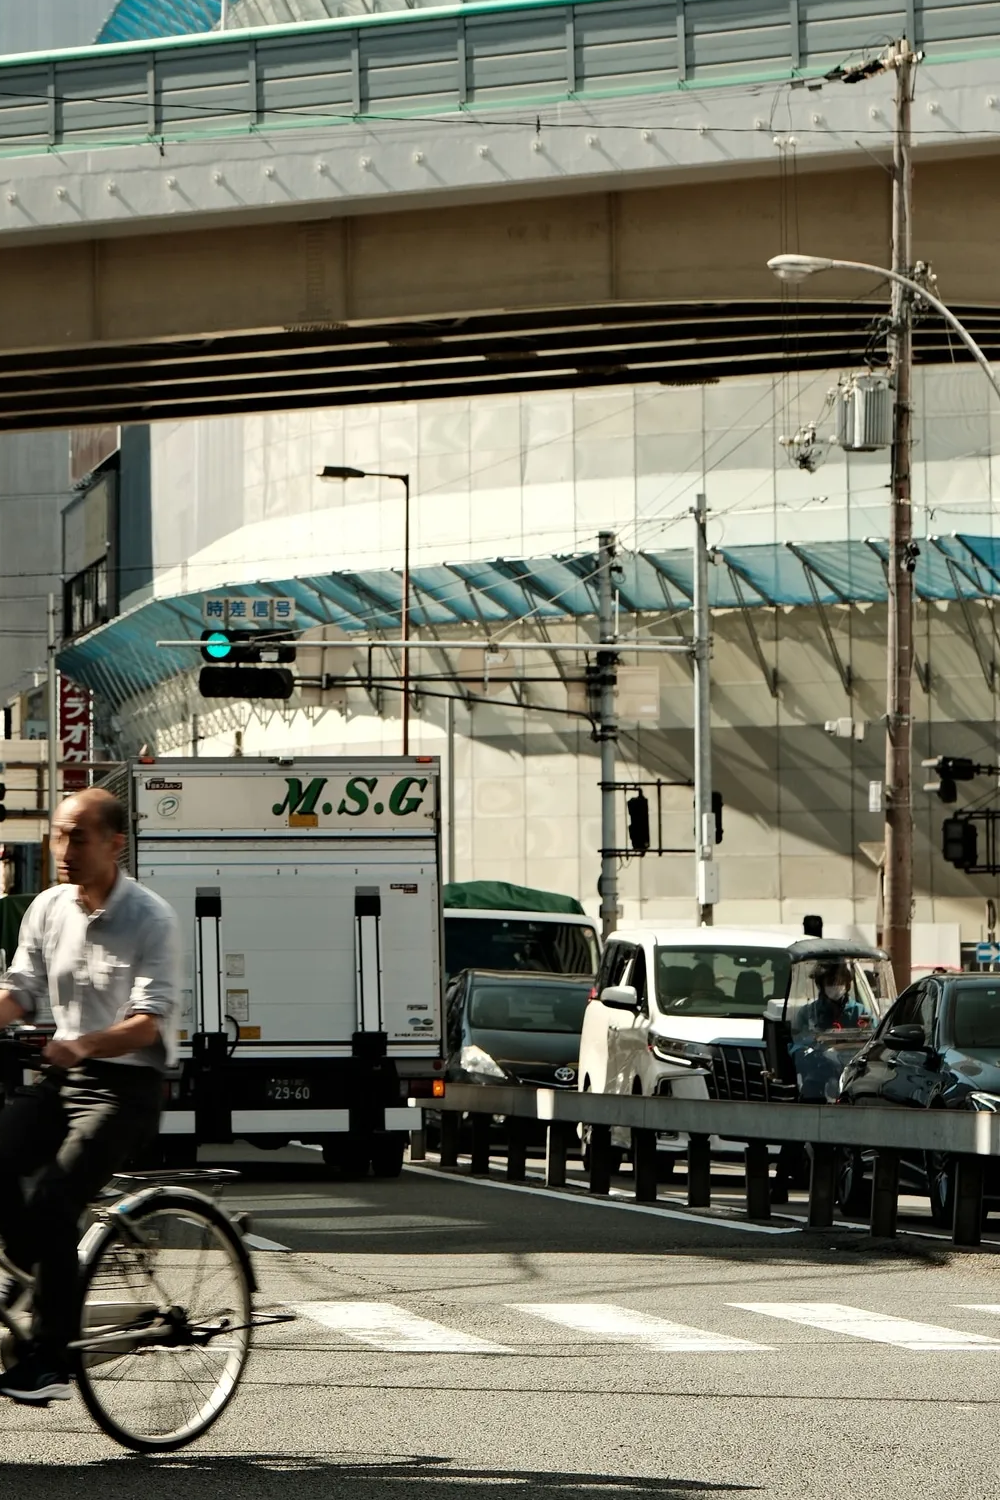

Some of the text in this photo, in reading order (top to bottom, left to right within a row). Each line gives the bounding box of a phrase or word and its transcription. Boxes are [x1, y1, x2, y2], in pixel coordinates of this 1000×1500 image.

[207, 601, 291, 618] 時差信号
[275, 1086, 310, 1100] 29-60
